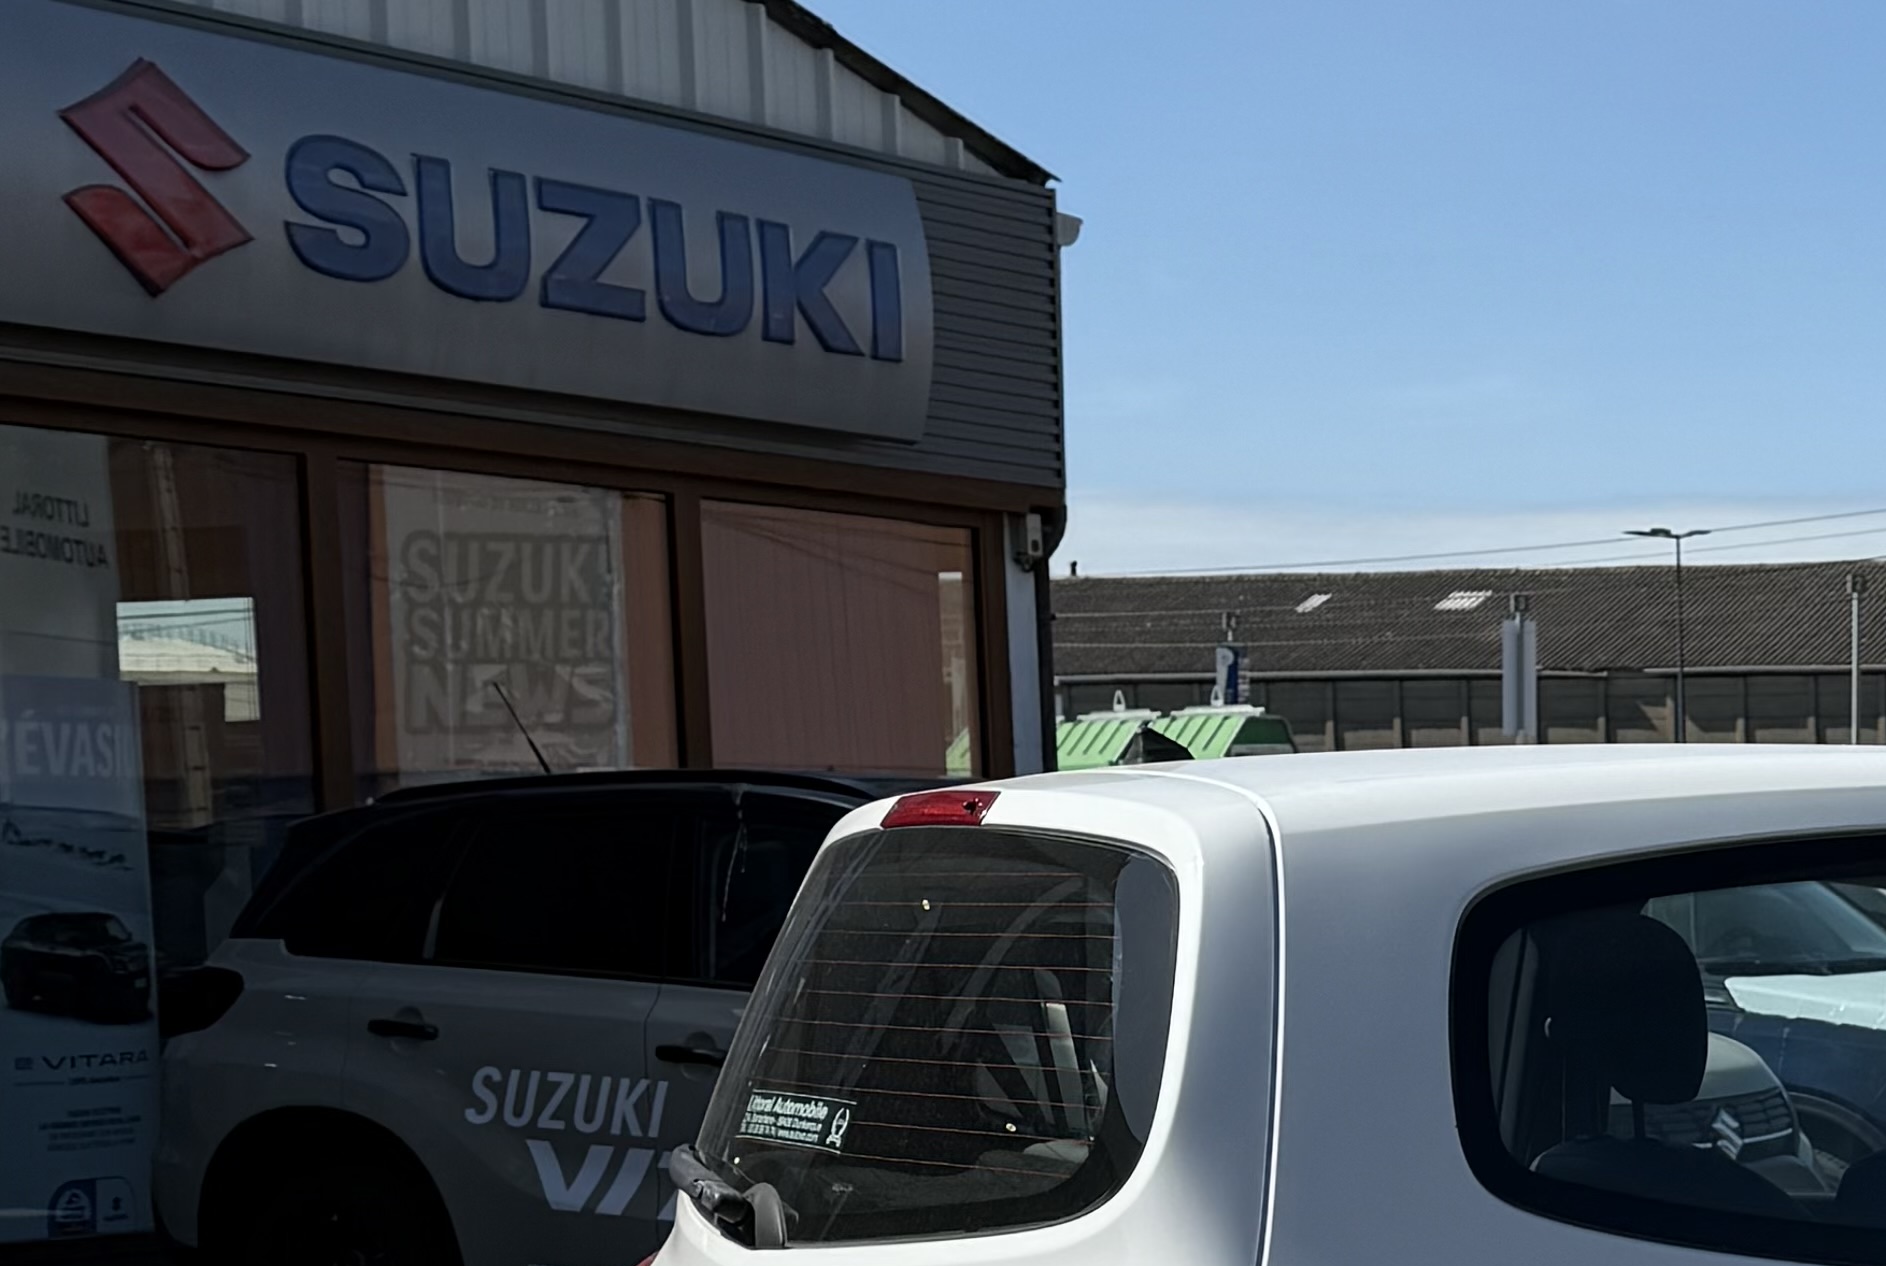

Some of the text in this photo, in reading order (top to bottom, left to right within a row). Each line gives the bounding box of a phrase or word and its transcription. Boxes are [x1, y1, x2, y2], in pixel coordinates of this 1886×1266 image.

[282, 133, 904, 363] SUZUKI
[409, 606, 611, 660] SUMMER
[42, 1049, 149, 1071] VITARA
[464, 1065, 669, 1138] SUZUKI
